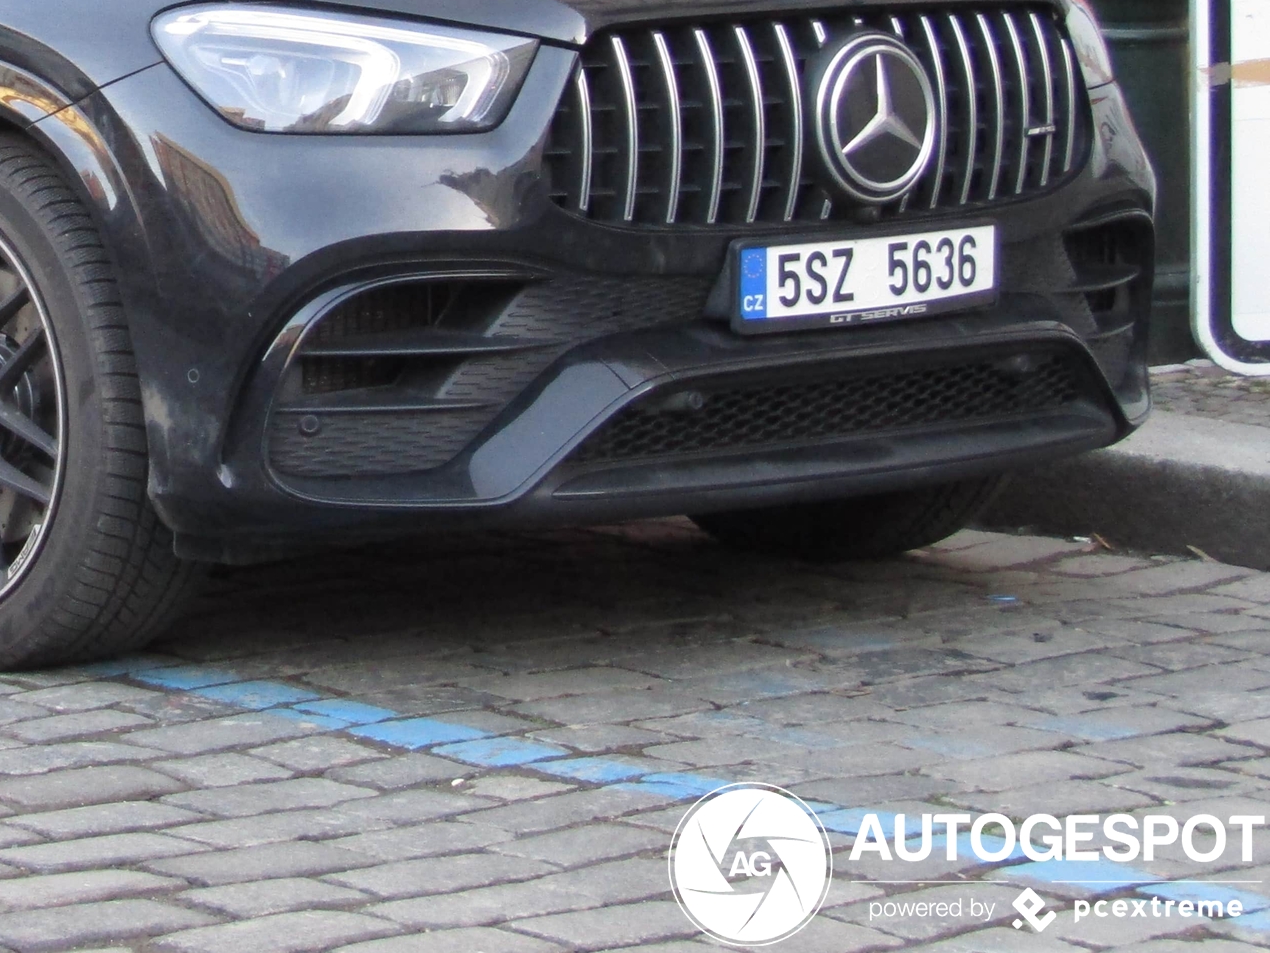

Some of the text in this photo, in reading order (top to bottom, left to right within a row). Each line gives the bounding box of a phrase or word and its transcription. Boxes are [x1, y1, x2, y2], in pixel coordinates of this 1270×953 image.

[778, 234, 977, 308] 5SZ 5636
[743, 294, 764, 312] CZ
[860, 304, 927, 321] SERVIS
